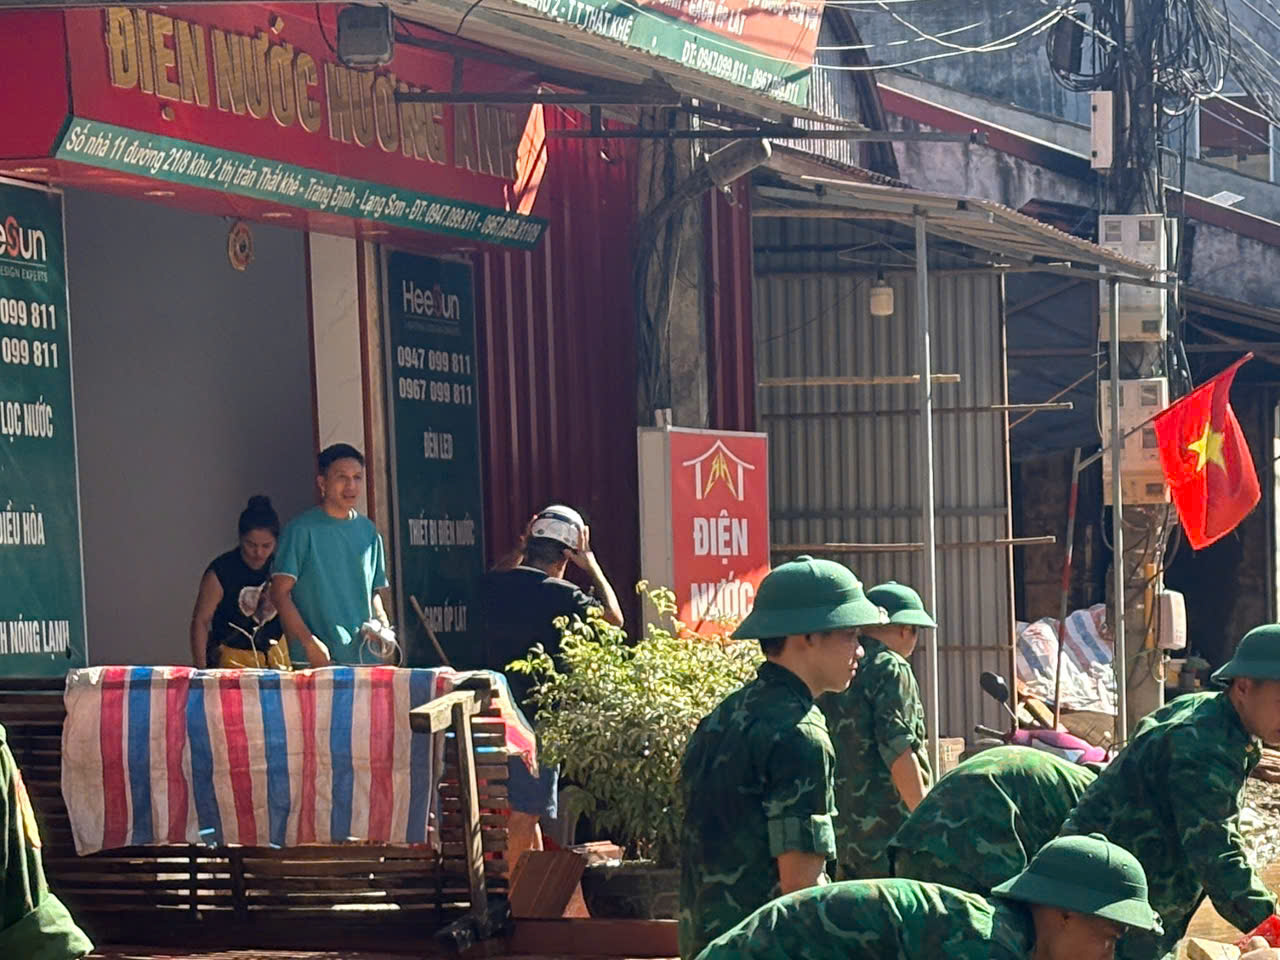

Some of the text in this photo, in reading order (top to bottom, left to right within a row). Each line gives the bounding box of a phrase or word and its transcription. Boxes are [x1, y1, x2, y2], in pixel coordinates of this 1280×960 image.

[727, 9, 747, 36] LÁT
[210, 14, 322, 134] NƯỚC
[65, 123, 92, 152] Số
[83, 132, 113, 158] nhà
[109, 136, 129, 160] 11
[186, 152, 212, 180] khu
[207, 157, 223, 180] 2
[1, 298, 57, 331] 099 811
[2, 336, 59, 369] 099 811
[397, 345, 471, 375] 0947 099 811
[399, 376, 473, 406] 0967 099 811
[24, 394, 54, 438] NƯỚC
[23, 503, 45, 546] HÒA
[692, 508, 749, 566] ĐIỆN
[689, 570, 755, 623] NƯỚC
[10, 614, 40, 655] NÓNG
